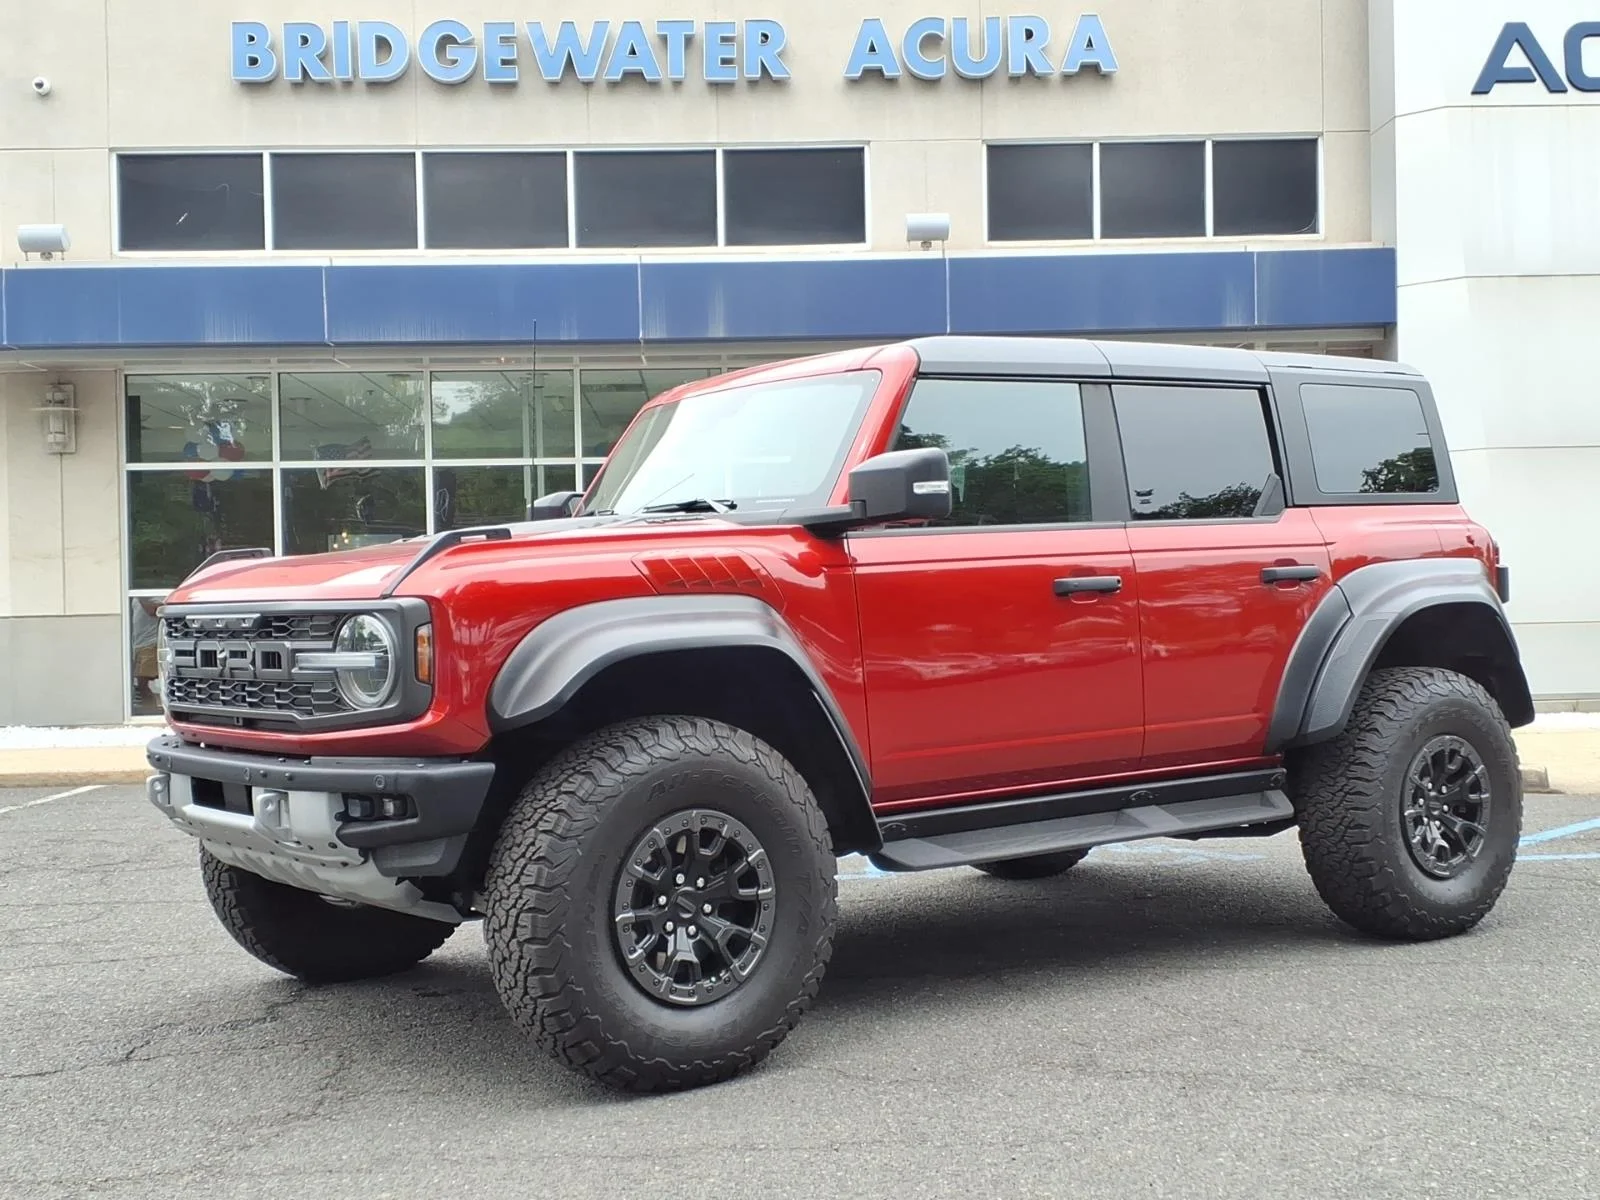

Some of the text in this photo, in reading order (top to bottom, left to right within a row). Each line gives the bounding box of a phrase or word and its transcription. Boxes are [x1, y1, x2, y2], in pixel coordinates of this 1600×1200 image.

[231, 13, 1120, 84] BRIDGEWATER ACURA
[166, 640, 291, 681] FORD
